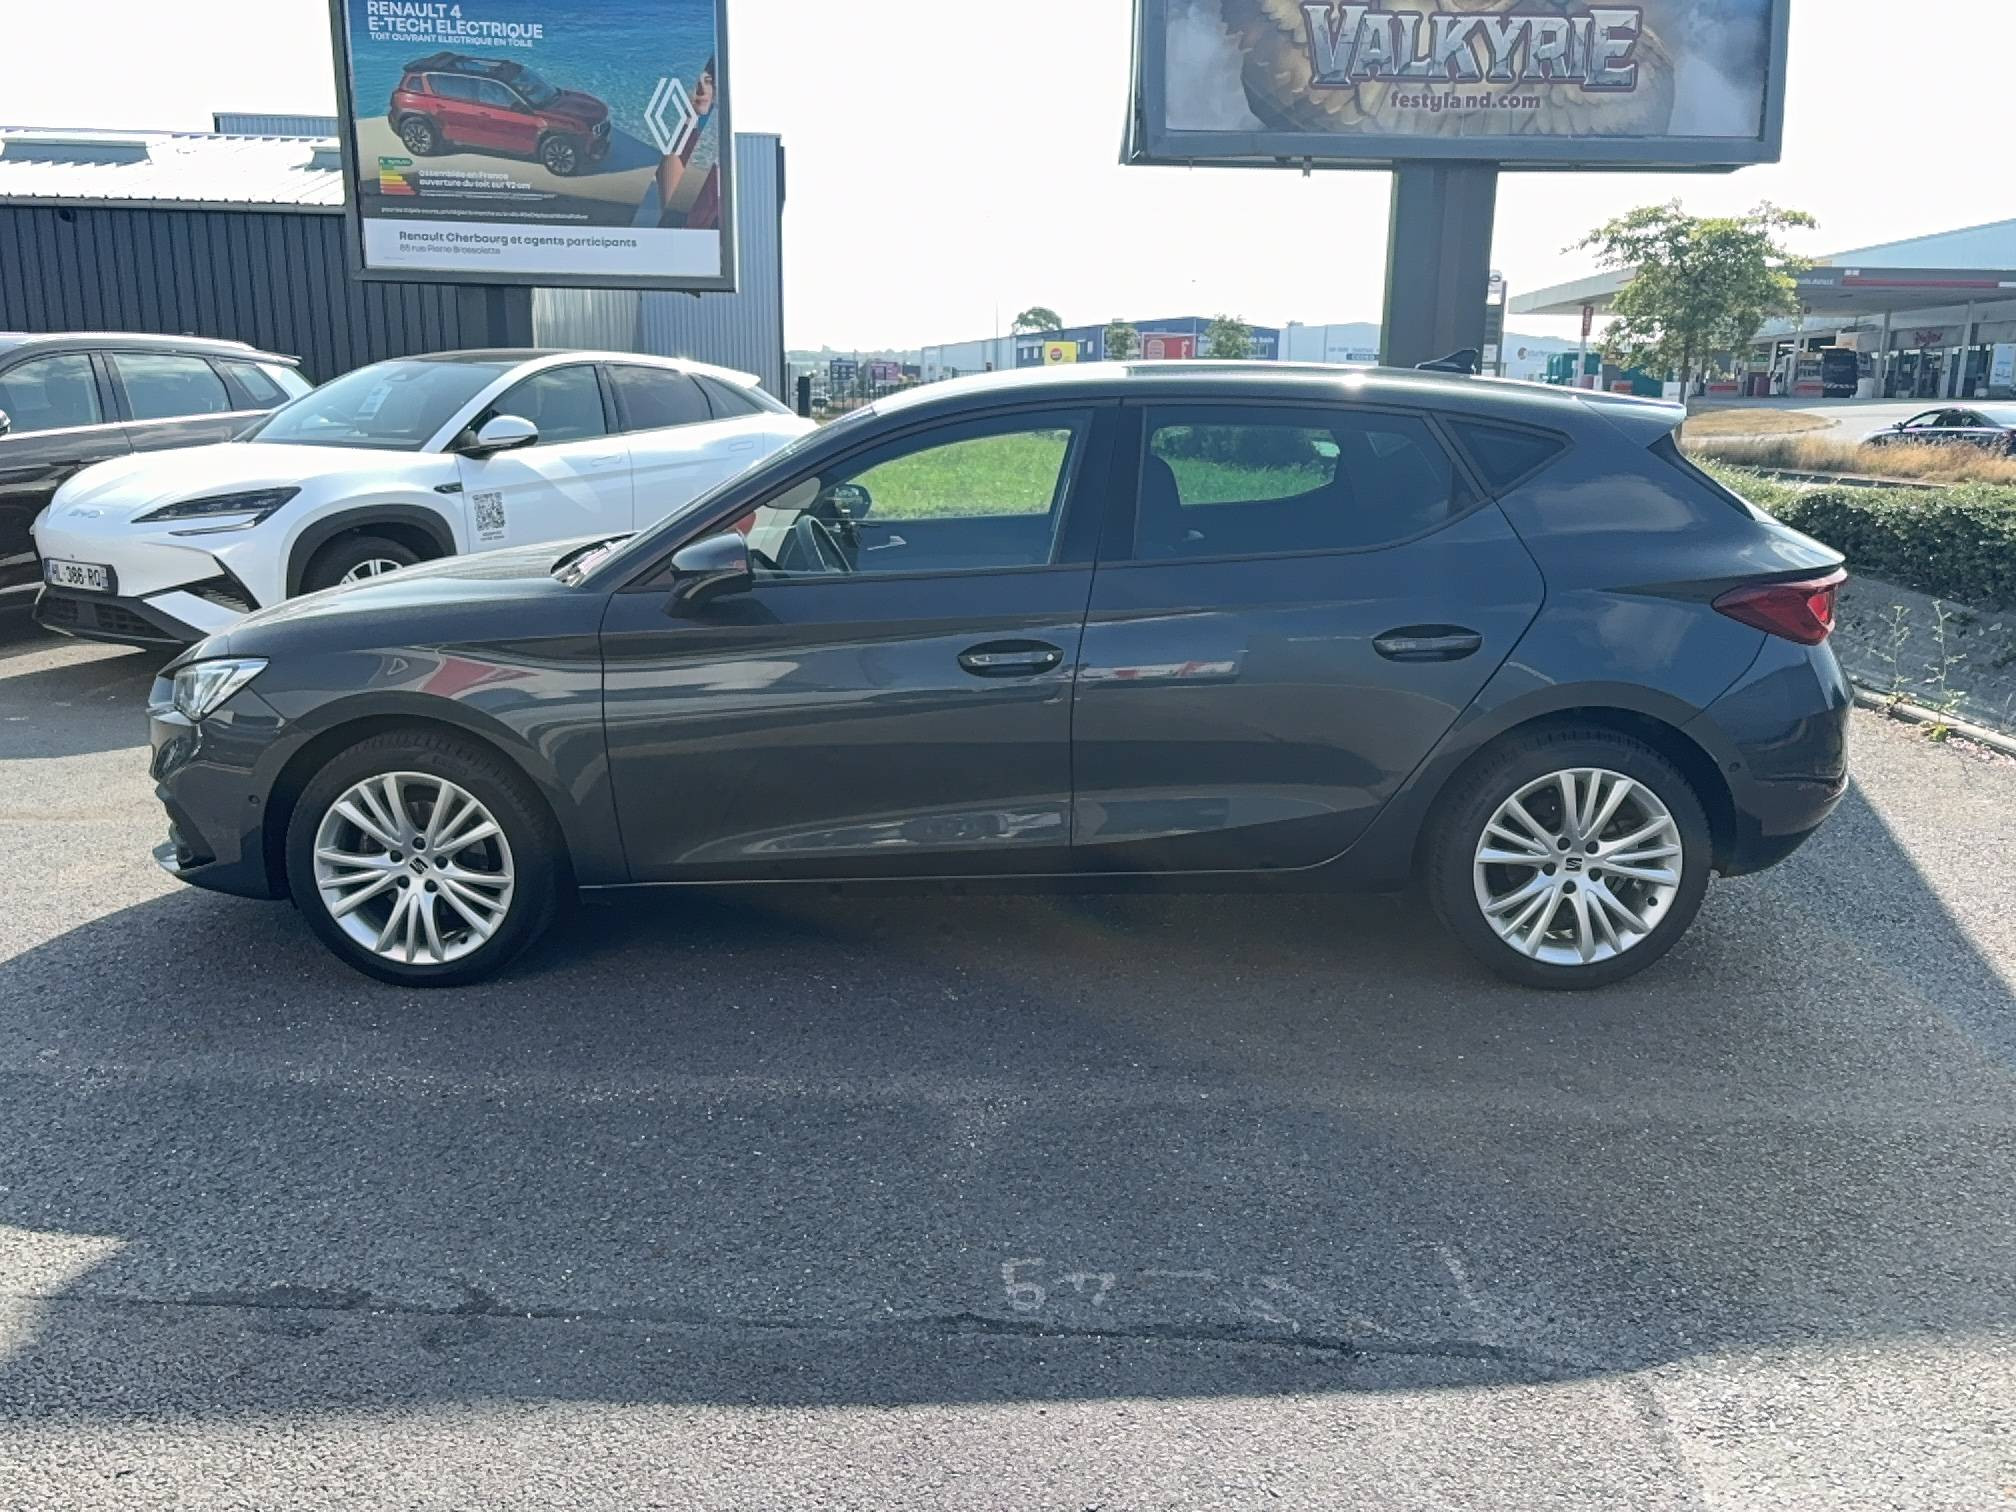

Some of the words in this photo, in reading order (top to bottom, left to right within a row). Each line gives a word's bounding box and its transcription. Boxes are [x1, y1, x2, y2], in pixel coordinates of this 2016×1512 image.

[367, 1, 447, 18] RENAULT
[450, 4, 463, 19] 4
[368, 16, 433, 33] E-TECH
[436, 20, 543, 39] ELECTRIQUE
[369, 32, 390, 41] TOIT
[391, 33, 437, 43] OUVRANT
[438, 35, 493, 46] ELECTRIQUE
[494, 38, 507, 46] EN
[508, 39, 533, 48] TOILE
[1303, 4, 1641, 89] VALKYRIE
[1390, 90, 1541, 113] festyland.com
[399, 231, 444, 242] Renault
[446, 232, 509, 246] Cherbourg
[510, 236, 522, 245] et
[524, 237, 565, 247] agents
[566, 237, 637, 249] participants
